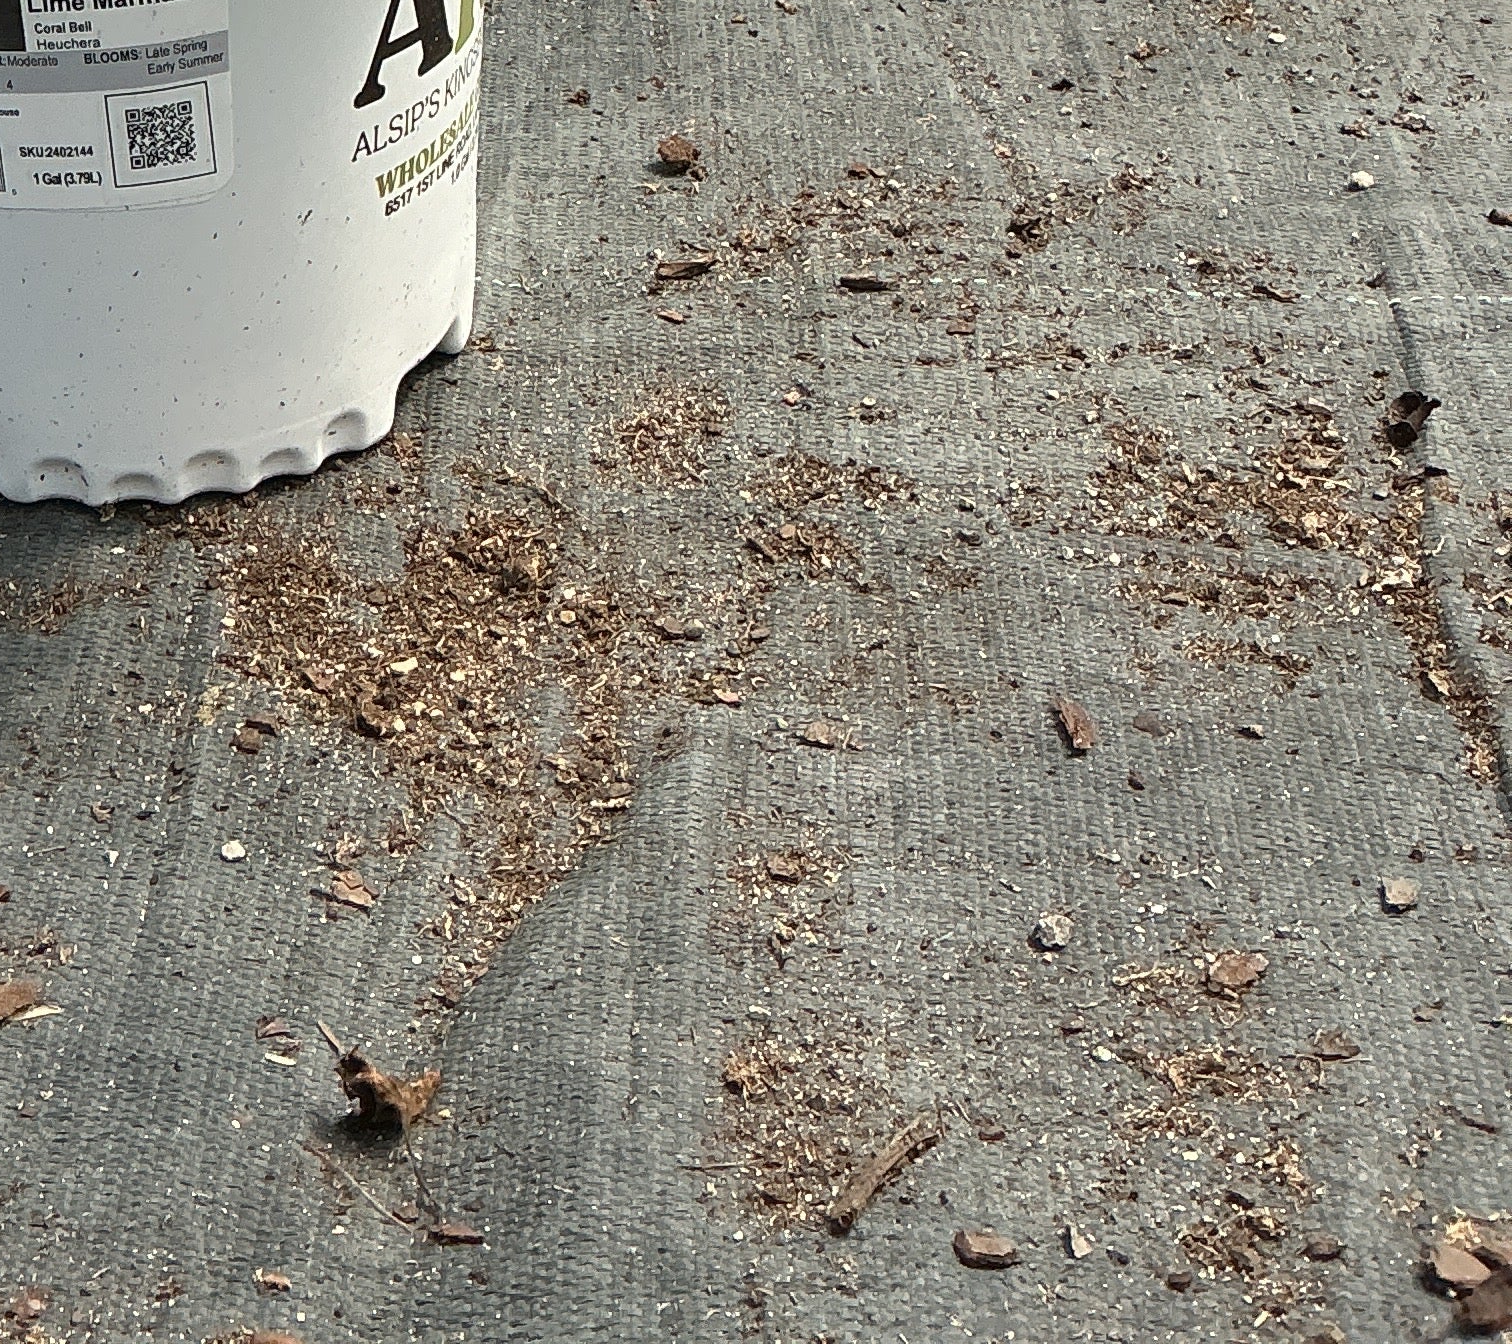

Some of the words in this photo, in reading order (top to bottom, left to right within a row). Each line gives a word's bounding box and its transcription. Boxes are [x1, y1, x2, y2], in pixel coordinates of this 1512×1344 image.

[33, 21, 67, 35] Coral
[69, 20, 93, 34] Bell
[36, 38, 102, 51] Heuchera
[83, 48, 142, 66] BLOOMS:
[144, 46, 170, 60] Late
[172, 38, 208, 56] Spring
[147, 61, 176, 75] Early
[178, 52, 224, 70] Summer
[6, 79, 14, 91] 4
[351, 87, 441, 163] ALSIP'S
[33, 173, 39, 186] 1
[41, 172, 62, 186] Gal
[63, 171, 103, 188] (3.79L)
